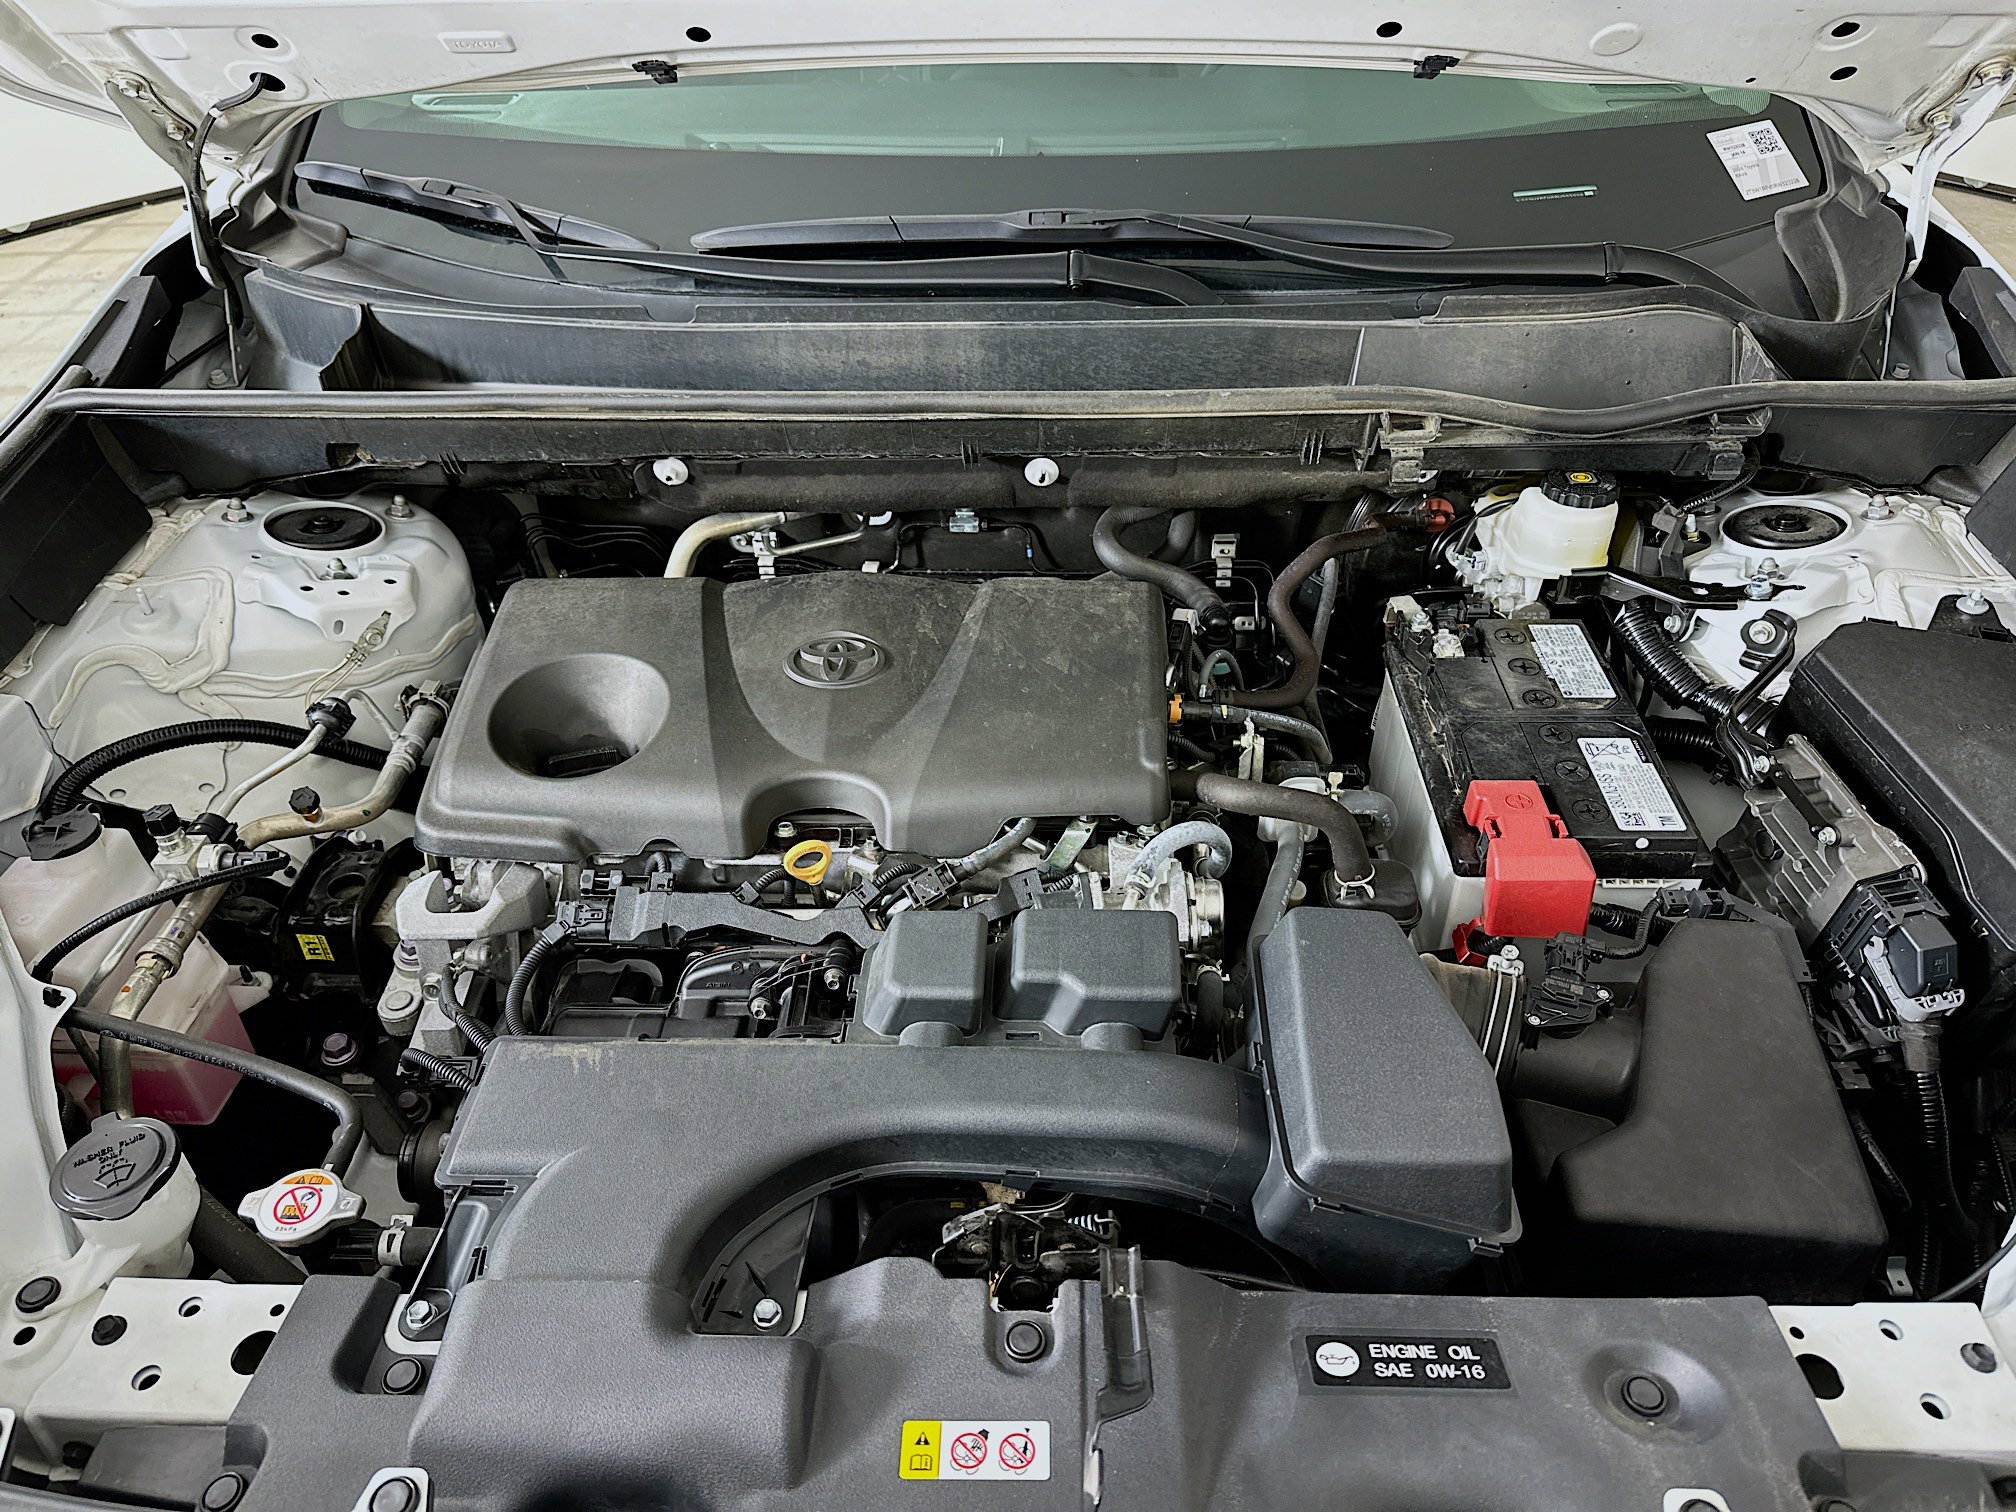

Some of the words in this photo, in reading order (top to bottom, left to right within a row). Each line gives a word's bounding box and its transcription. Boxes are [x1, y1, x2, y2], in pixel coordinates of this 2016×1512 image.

[73, 1146, 114, 1168] WASHER
[118, 1132, 146, 1148] FLUID
[1368, 1343, 1438, 1359] ENGINE
[1447, 1345, 1481, 1360] OIL
[1374, 1362, 1415, 1378] SAE
[1425, 1363, 1486, 1379] 0W-16
